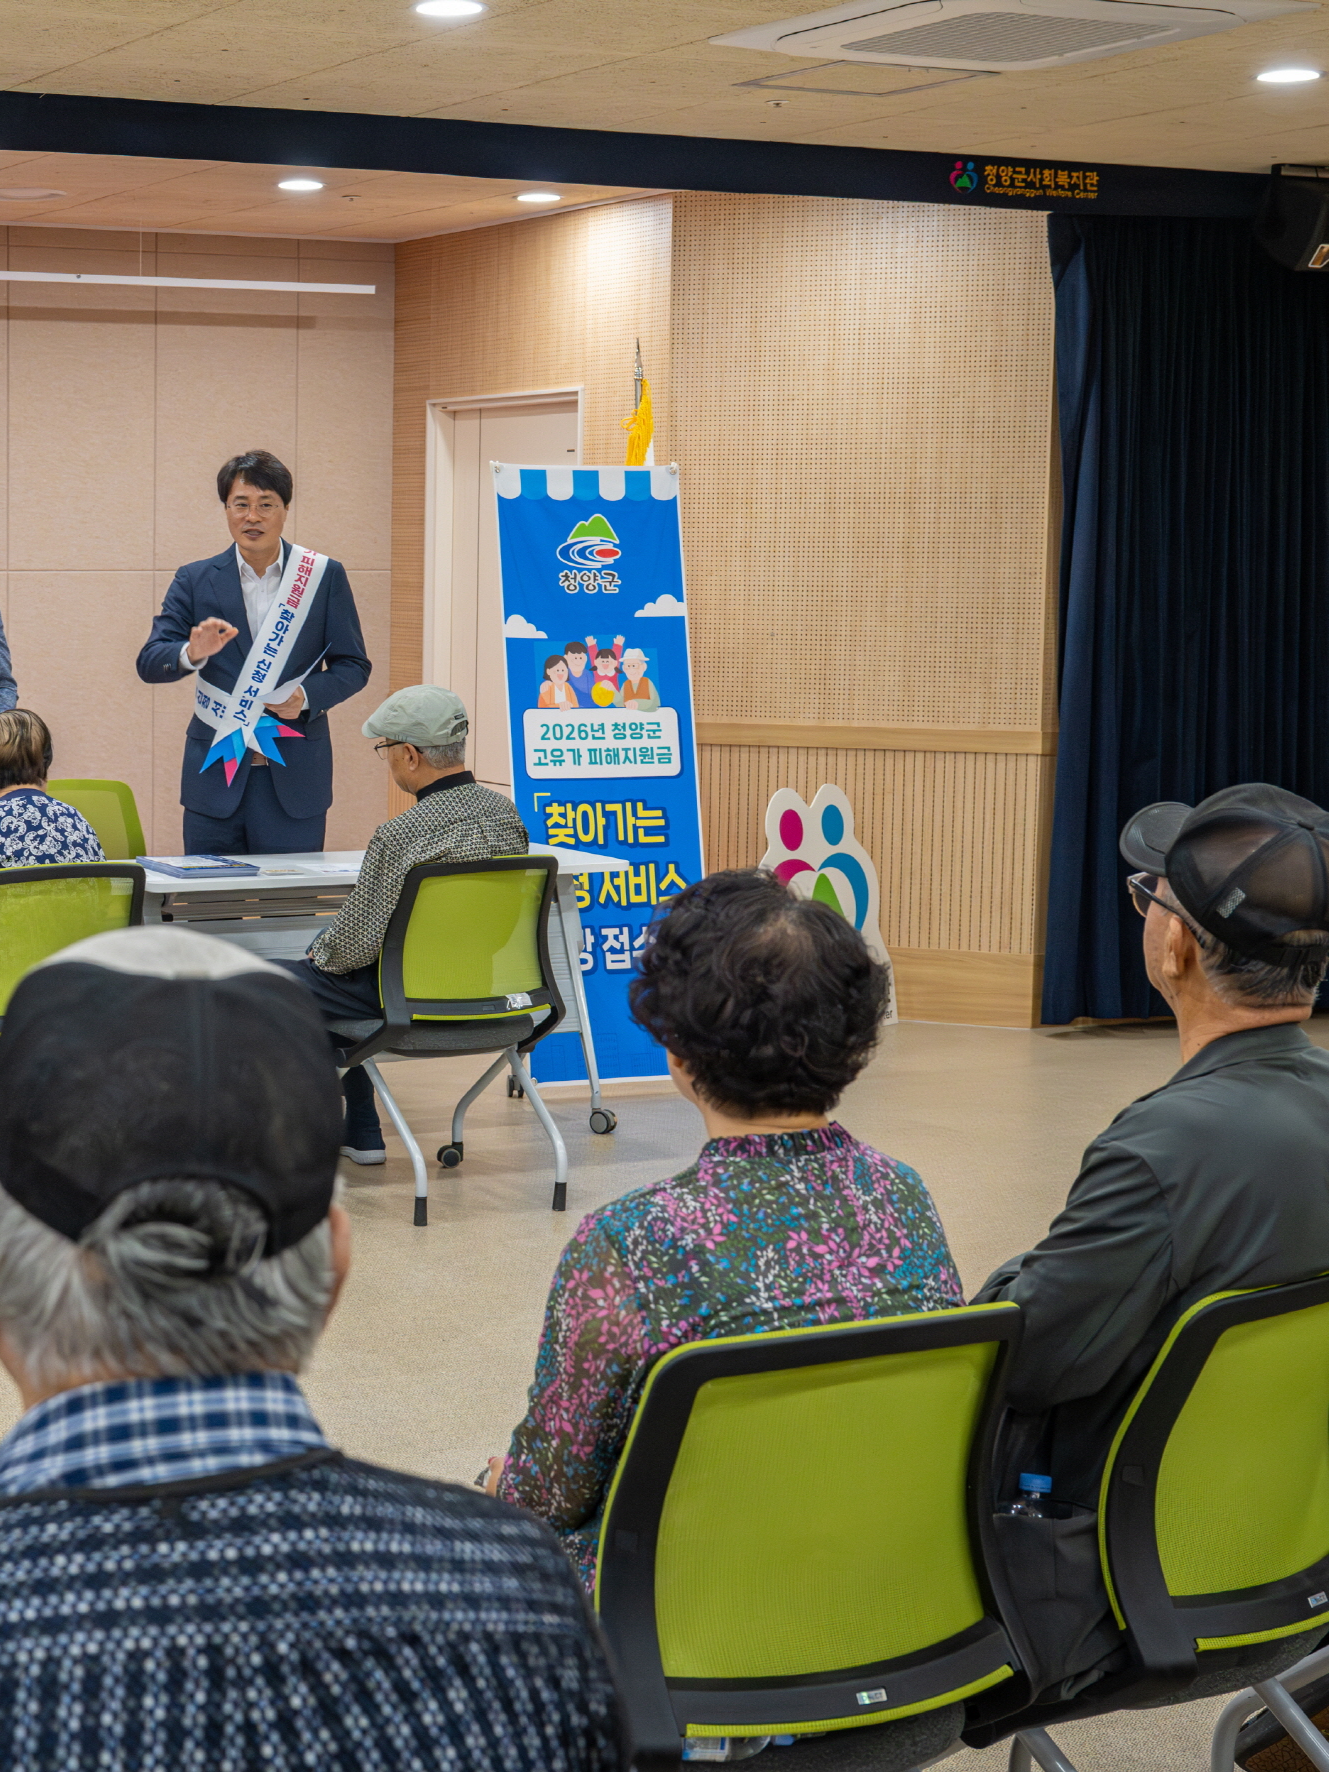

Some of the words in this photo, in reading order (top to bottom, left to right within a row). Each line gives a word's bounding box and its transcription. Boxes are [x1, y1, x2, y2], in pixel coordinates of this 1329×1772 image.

[984, 165, 1099, 190] 청양군사회복지관
[1074, 189, 1099, 199] Center
[286, 555, 316, 610] 피해지원금
[559, 569, 621, 594] 청양군
[251, 658, 272, 684] 신청
[540, 723, 606, 741] 2026년
[611, 721, 662, 740] 청양군
[533, 748, 582, 767] 고유가
[587, 746, 672, 766] 피해지원금
